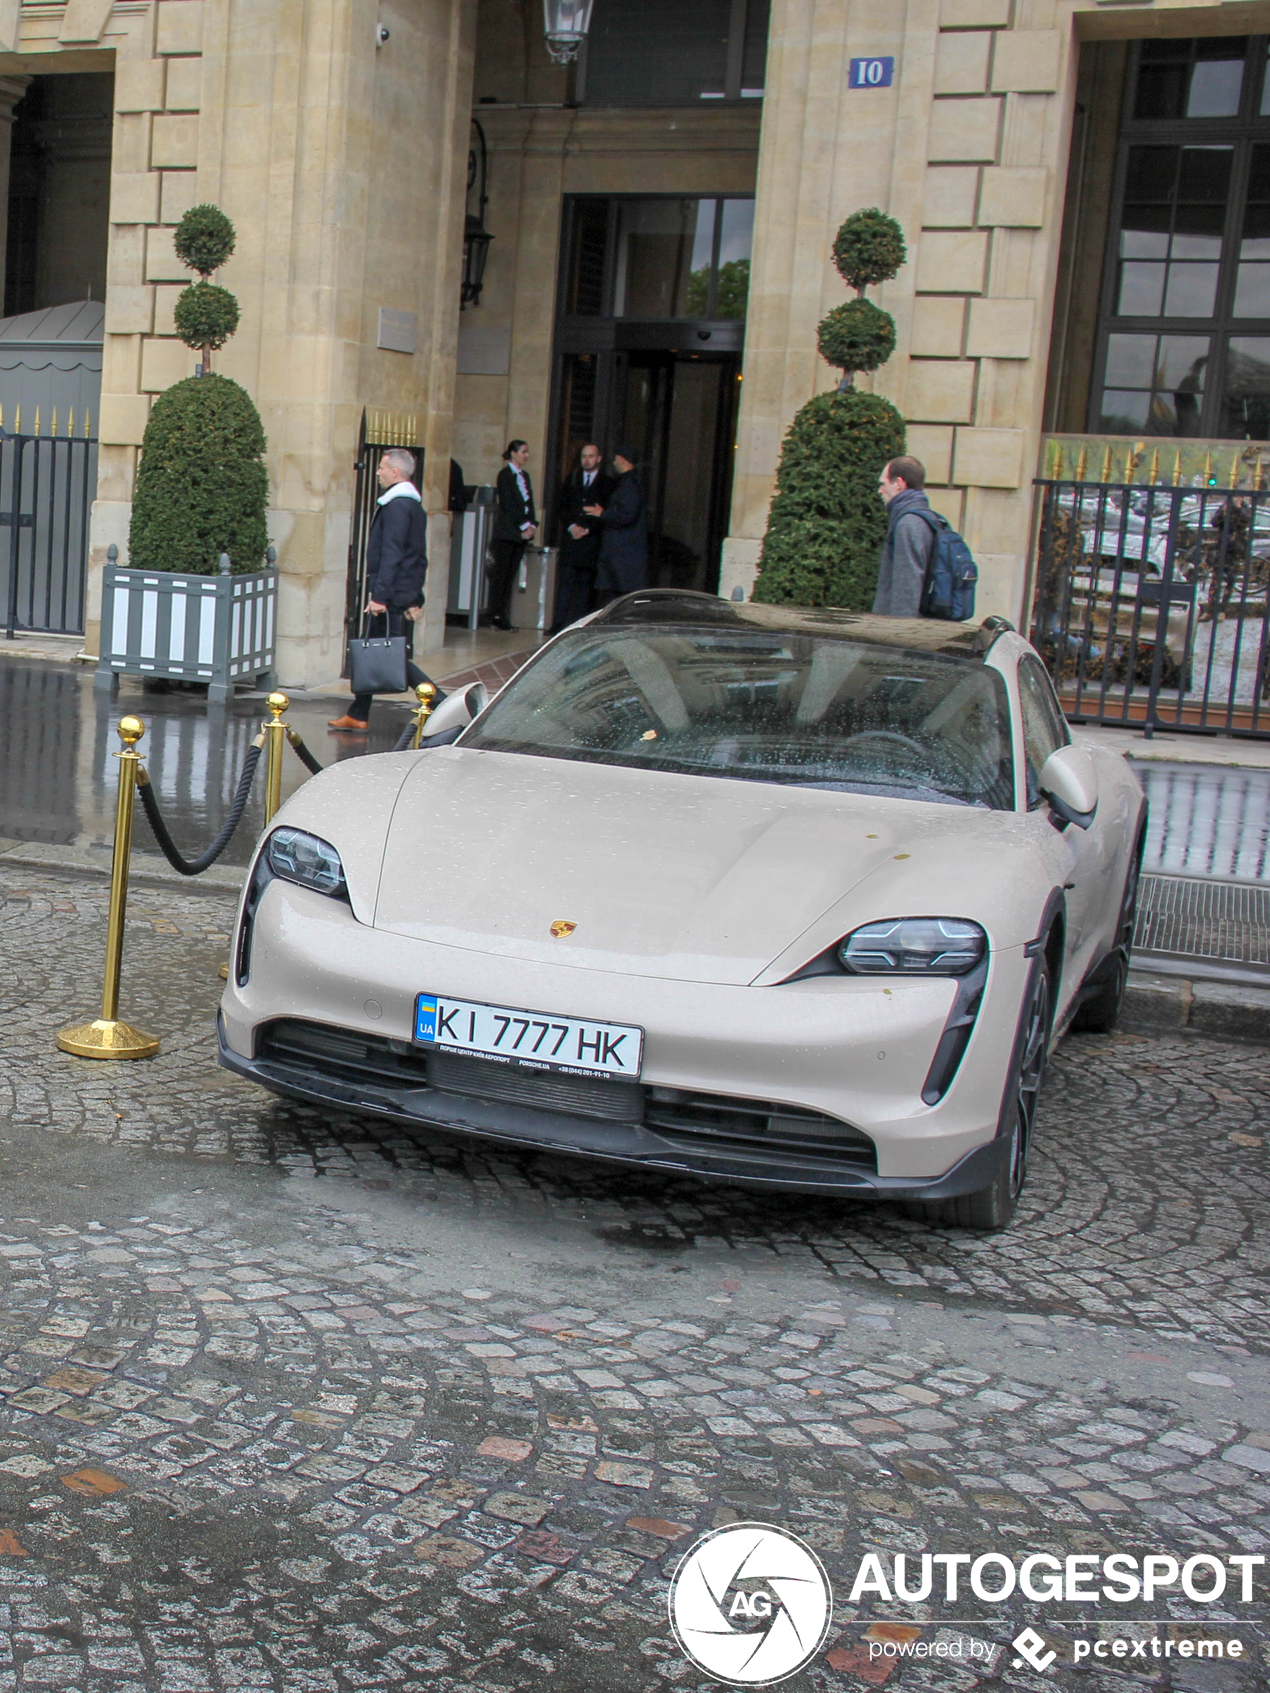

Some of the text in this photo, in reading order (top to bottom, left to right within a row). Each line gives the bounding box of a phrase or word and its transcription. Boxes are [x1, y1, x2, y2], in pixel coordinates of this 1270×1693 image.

[857, 61, 883, 84] 10
[420, 1023, 434, 1035] UA
[493, 1015, 569, 1056] 7777
[577, 1027, 628, 1067] HK
[519, 1060, 550, 1069] PORSCHE.UA
